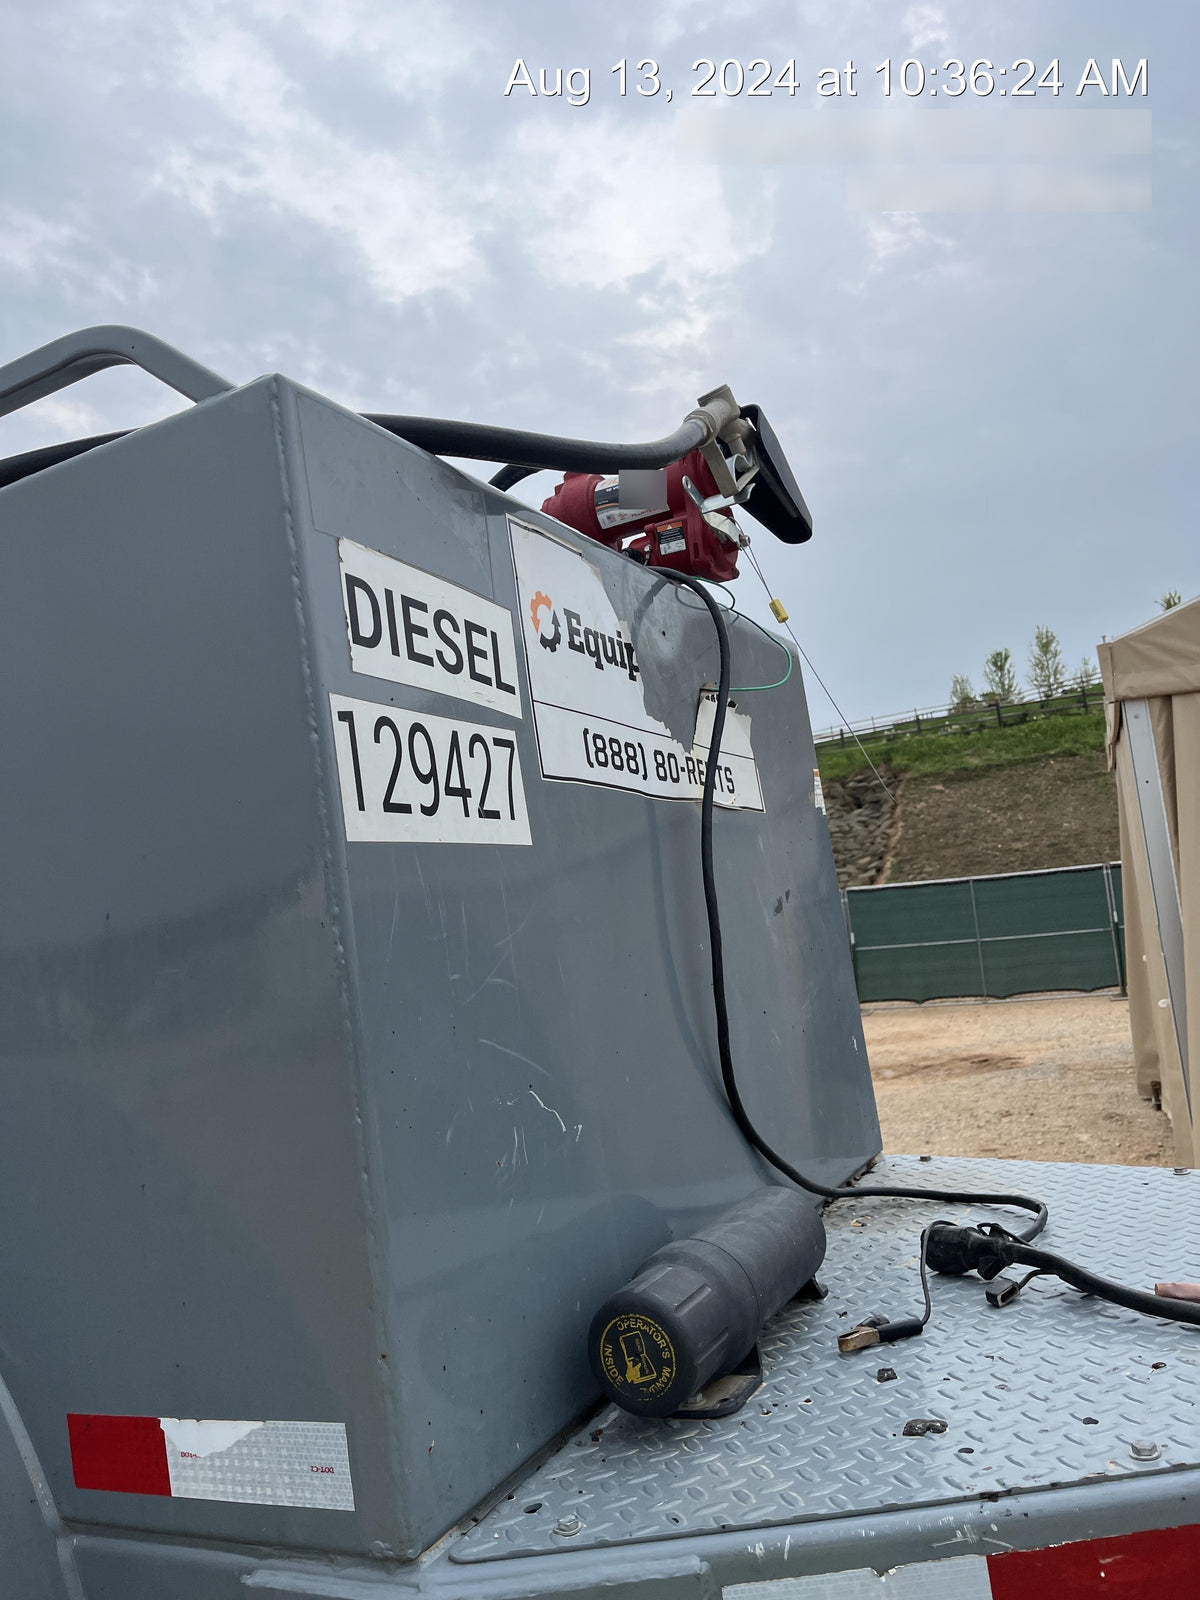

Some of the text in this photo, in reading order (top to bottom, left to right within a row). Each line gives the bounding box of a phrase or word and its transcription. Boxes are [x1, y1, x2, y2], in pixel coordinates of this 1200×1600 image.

[345, 573, 516, 695] DIESEL
[337, 711, 515, 820] 129427
[583, 728, 735, 794] (888) 80-RETS
[604, 1343, 624, 1385] INSIDE
[616, 1318, 670, 1359] OPERATOR'S
[310, 1465, 335, 1474] DOT-C2
